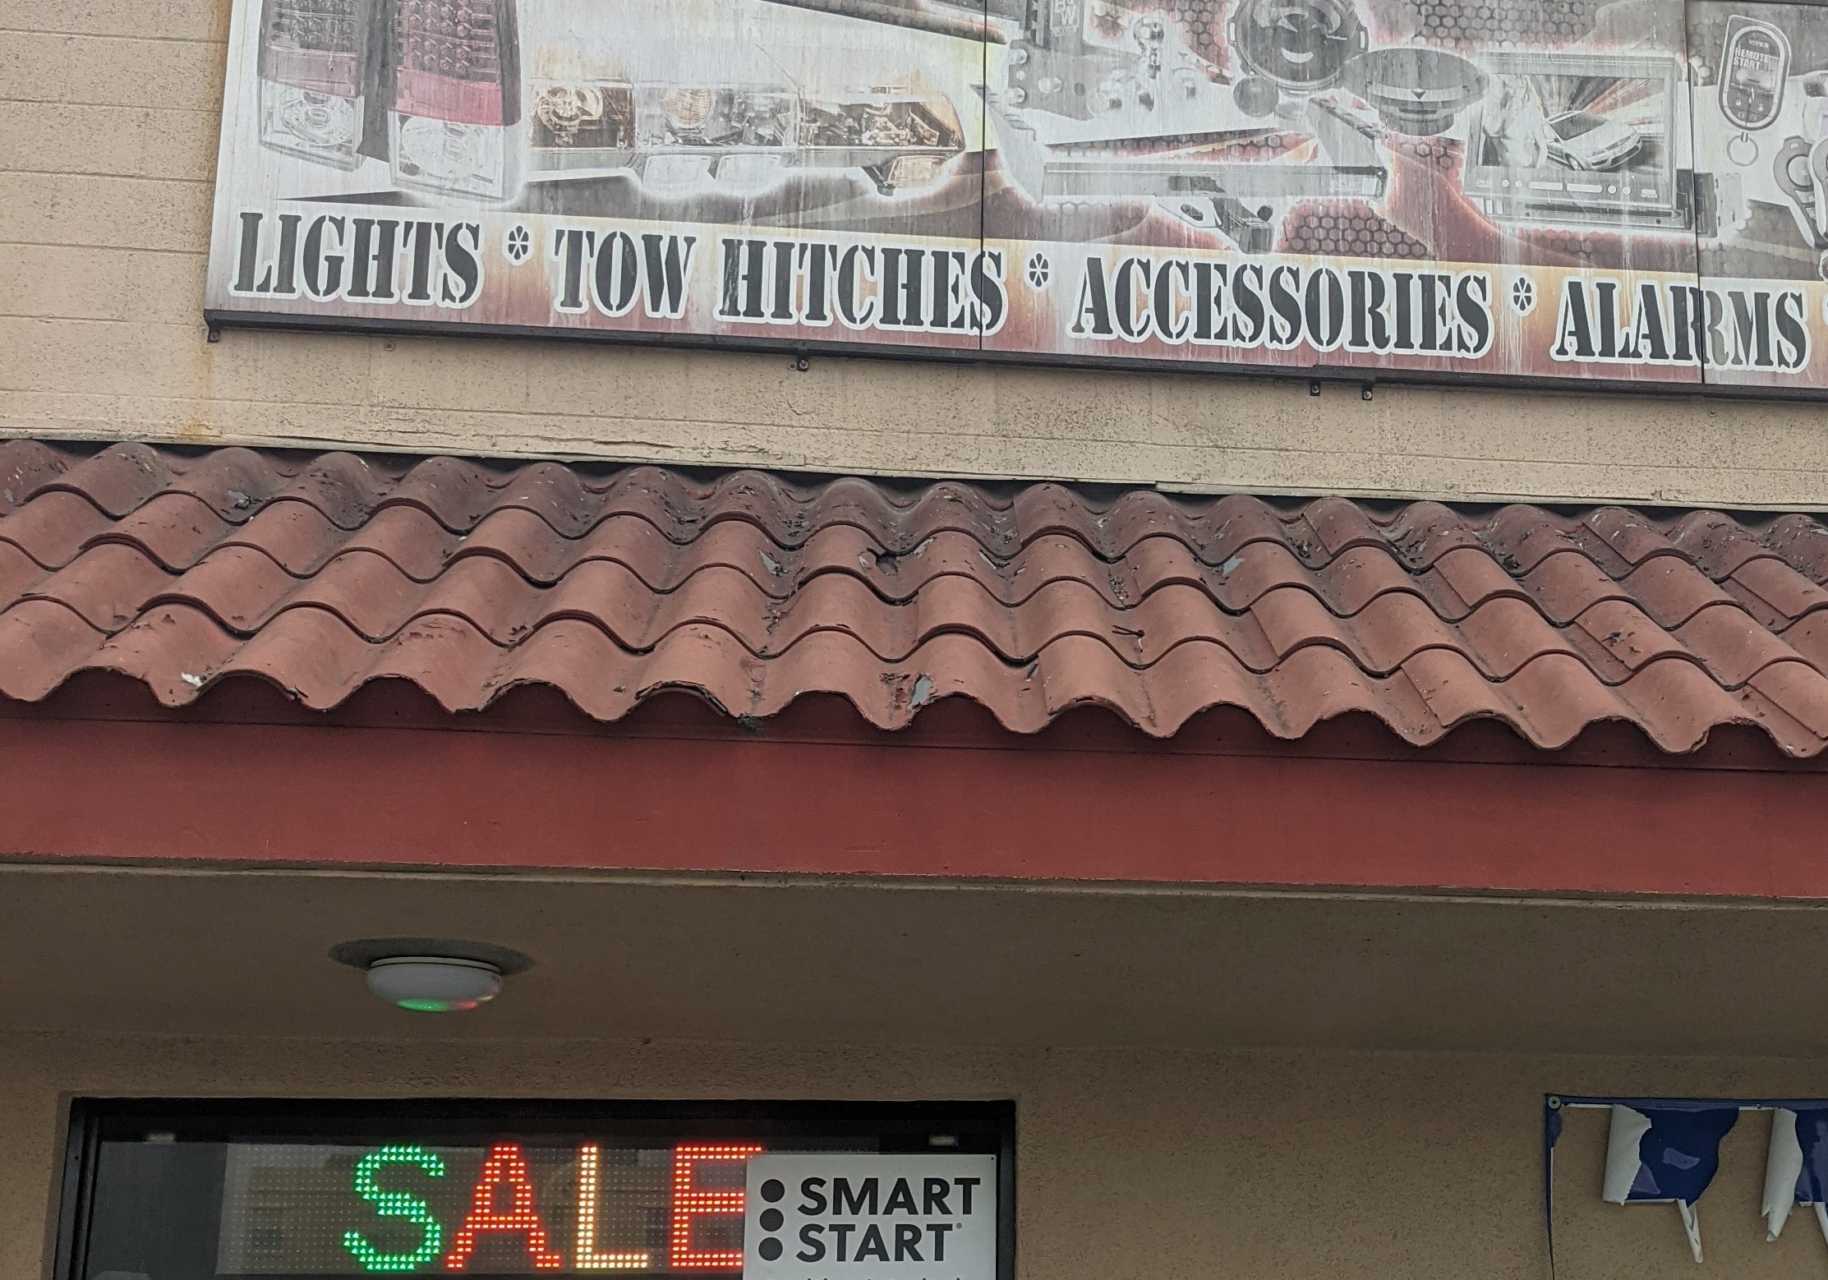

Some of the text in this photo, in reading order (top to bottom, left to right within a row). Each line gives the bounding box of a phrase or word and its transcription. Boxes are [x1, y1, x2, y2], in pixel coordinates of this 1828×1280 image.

[234, 211, 1807, 370] LIGHTS TOW HITCHES ACCESSORIES ALARMS
[343, 1143, 761, 1272] SALE
[797, 1176, 981, 1216] SMART
[796, 1223, 954, 1263] START
